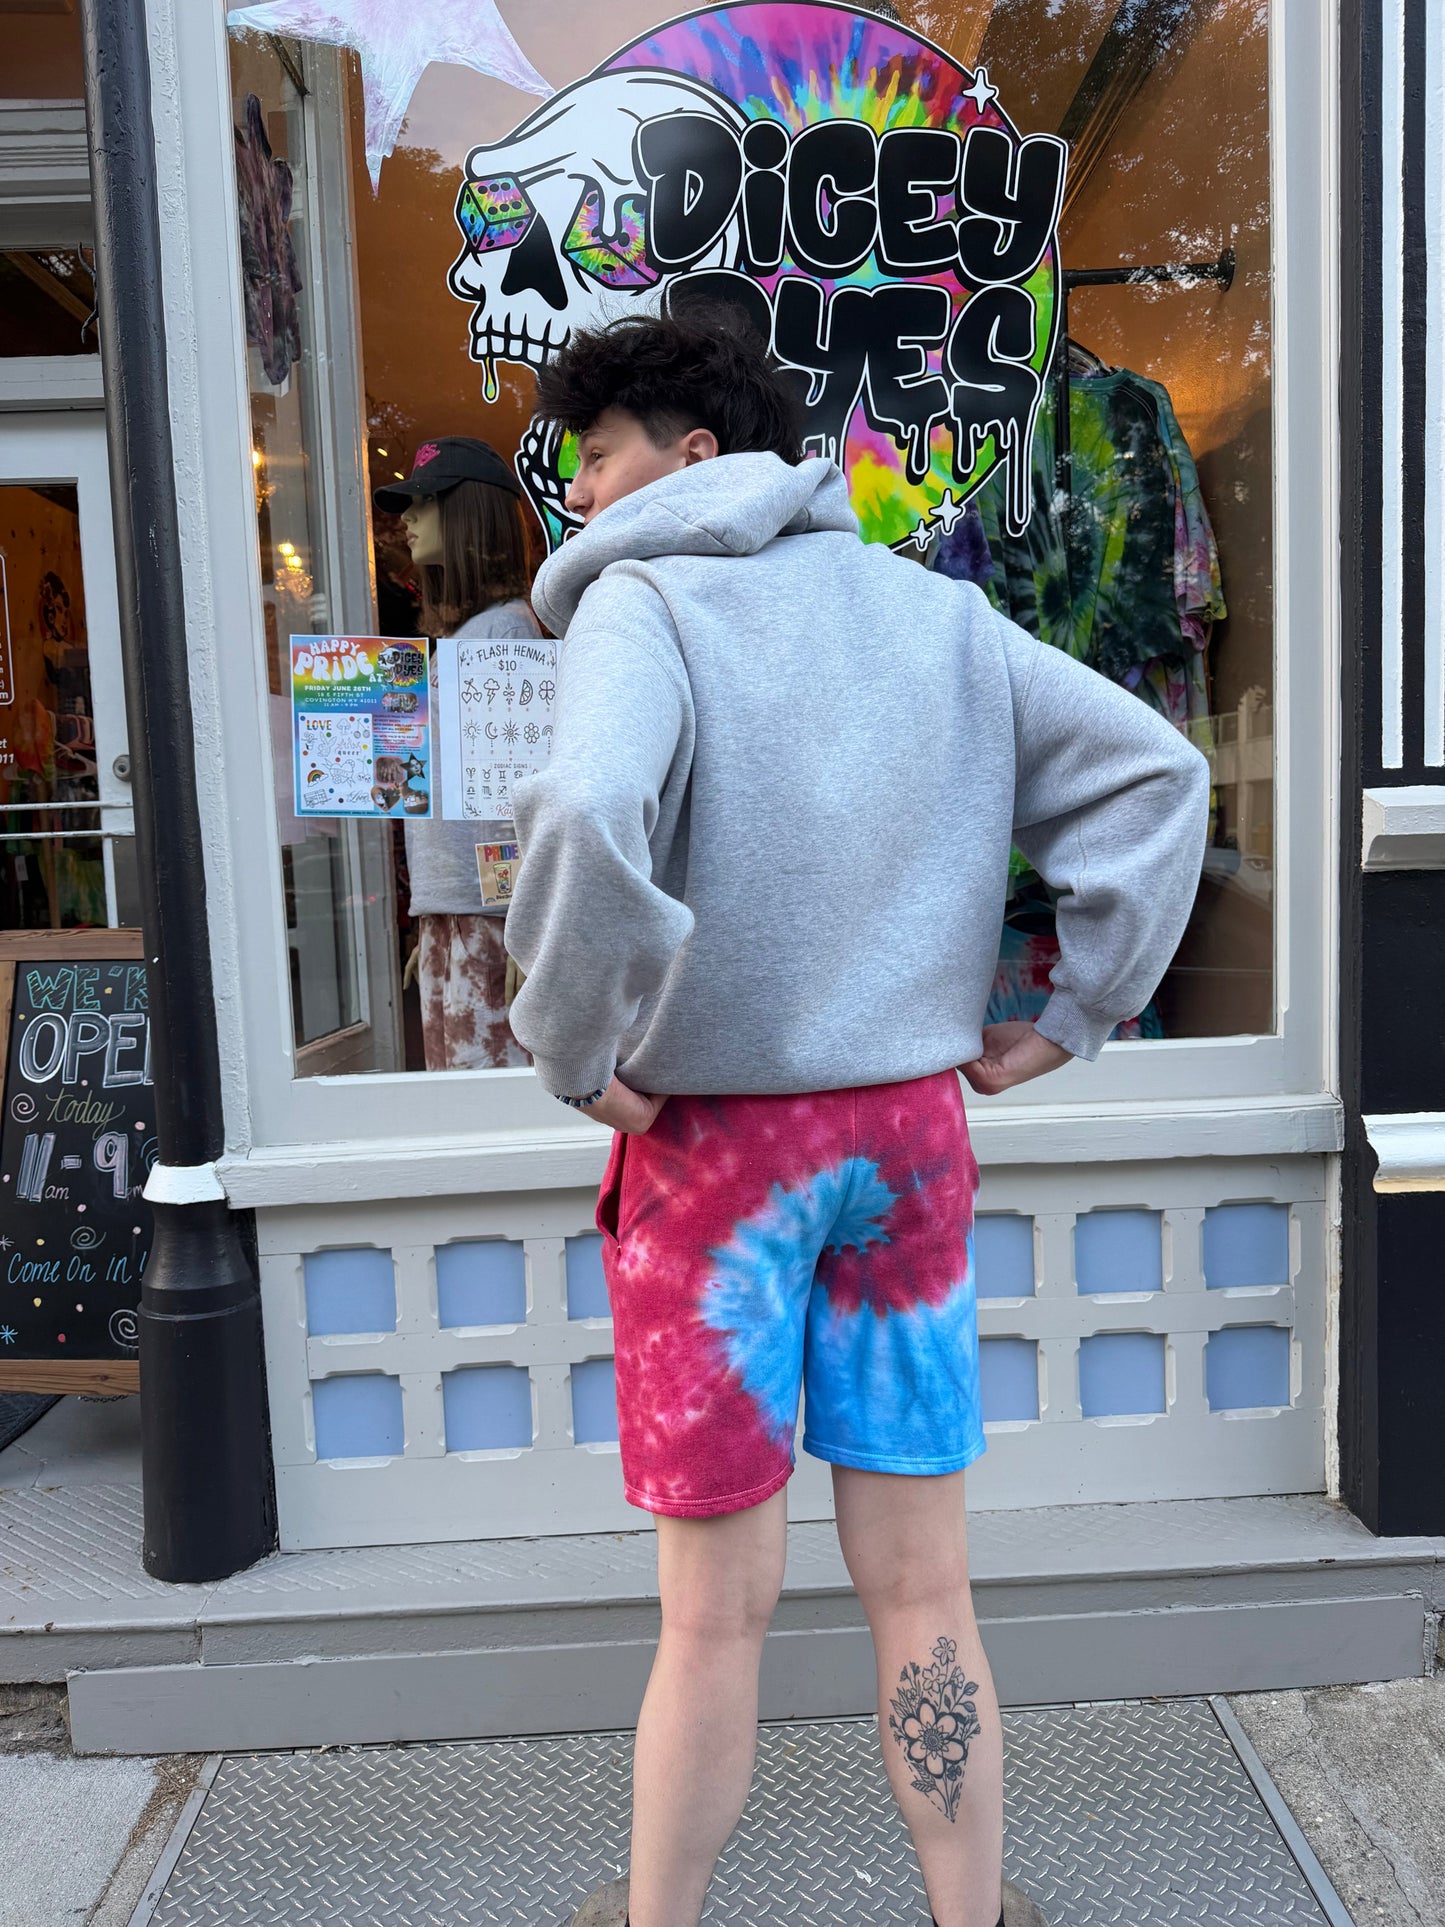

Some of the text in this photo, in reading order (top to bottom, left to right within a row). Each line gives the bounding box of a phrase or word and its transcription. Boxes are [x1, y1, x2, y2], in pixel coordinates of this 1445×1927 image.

[310, 640, 360, 656] HAPPY
[476, 644, 547, 666] FLASH HENNA
[369, 674, 383, 682] AT
[395, 664, 423, 677] DYES
[498, 659, 517, 671] $10
[306, 720, 332, 731] LOVE
[484, 844, 519, 862] PRIDE
[20, 1011, 154, 1089] OPE
[45, 1087, 126, 1141] today
[44, 1184, 70, 1200] am
[94, 1130, 129, 1199] 9
[7, 1252, 61, 1284] Come
